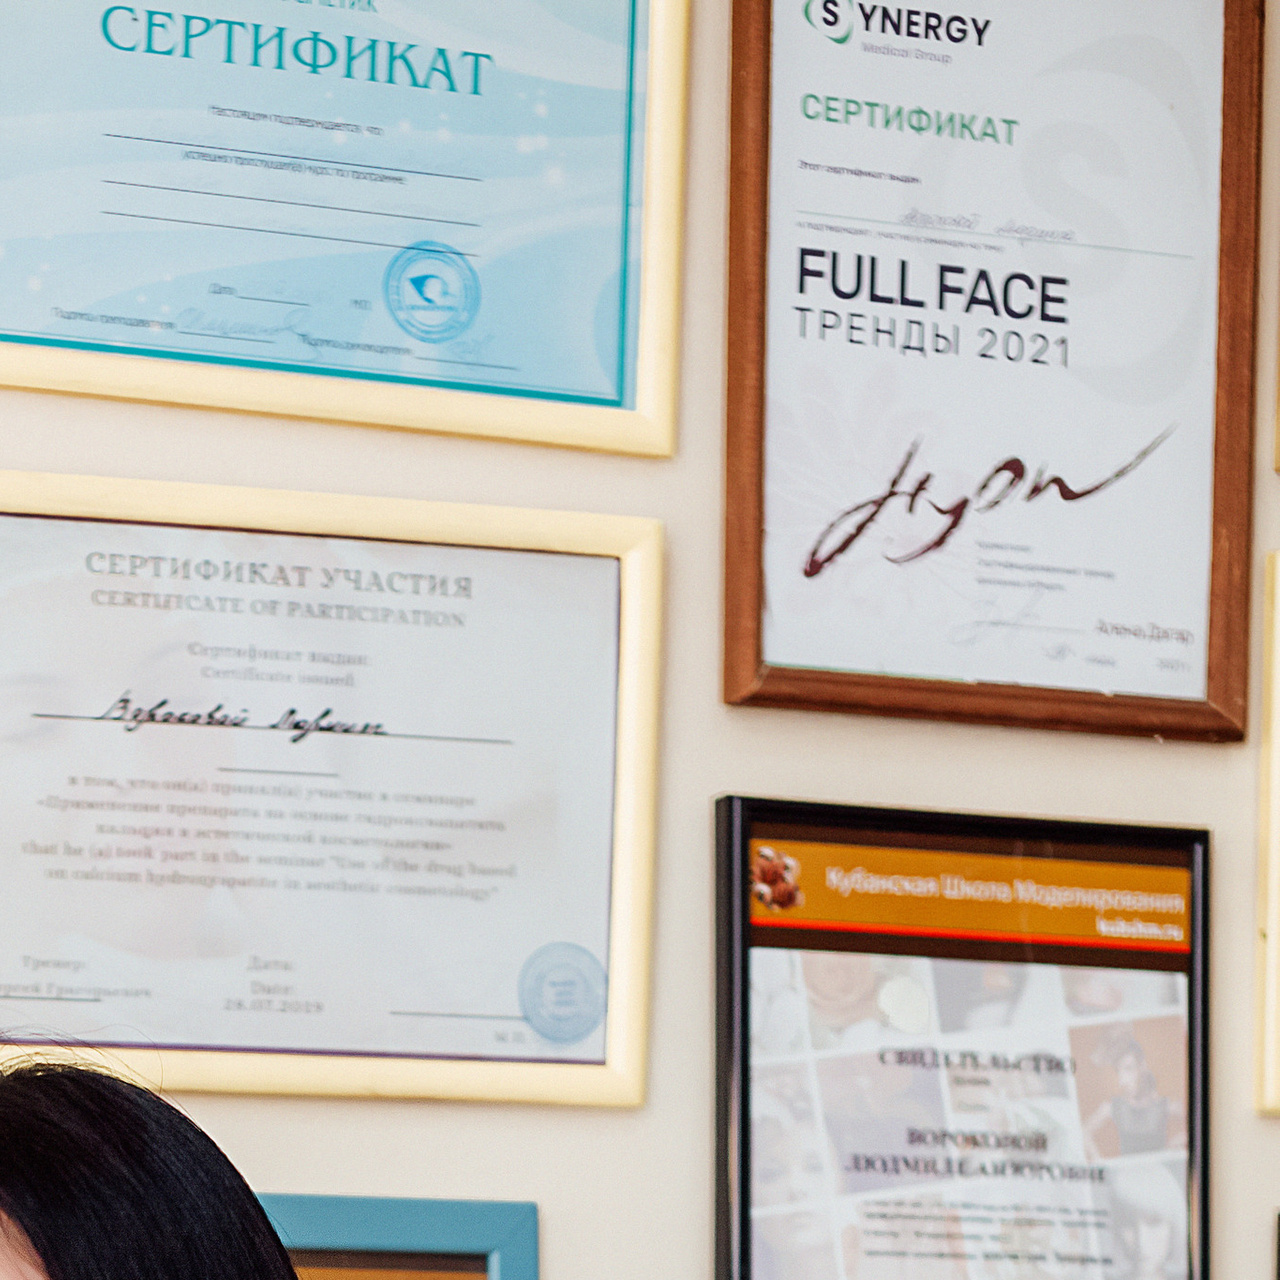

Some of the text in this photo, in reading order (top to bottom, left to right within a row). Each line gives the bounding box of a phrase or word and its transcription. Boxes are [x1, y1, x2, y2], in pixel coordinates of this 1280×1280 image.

[821, 0, 992, 48] SYNERGY
[100, 4, 494, 97] СЕРТИФИКАТ
[801, 93, 1020, 147] СЕРТИФИКАТ
[797, 247, 1071, 325] FULL FACE
[792, 305, 1069, 369] ТРЕНДЫ 2021
[84, 550, 475, 601] СЕРТИФИКАТ УЧАСТИЯ
[90, 588, 466, 629] CERTIFICATE OF PARTICIPATION
[186, 640, 304, 667] Сертификат
[825, 866, 1187, 915] Кубанская Школа Моделирования
